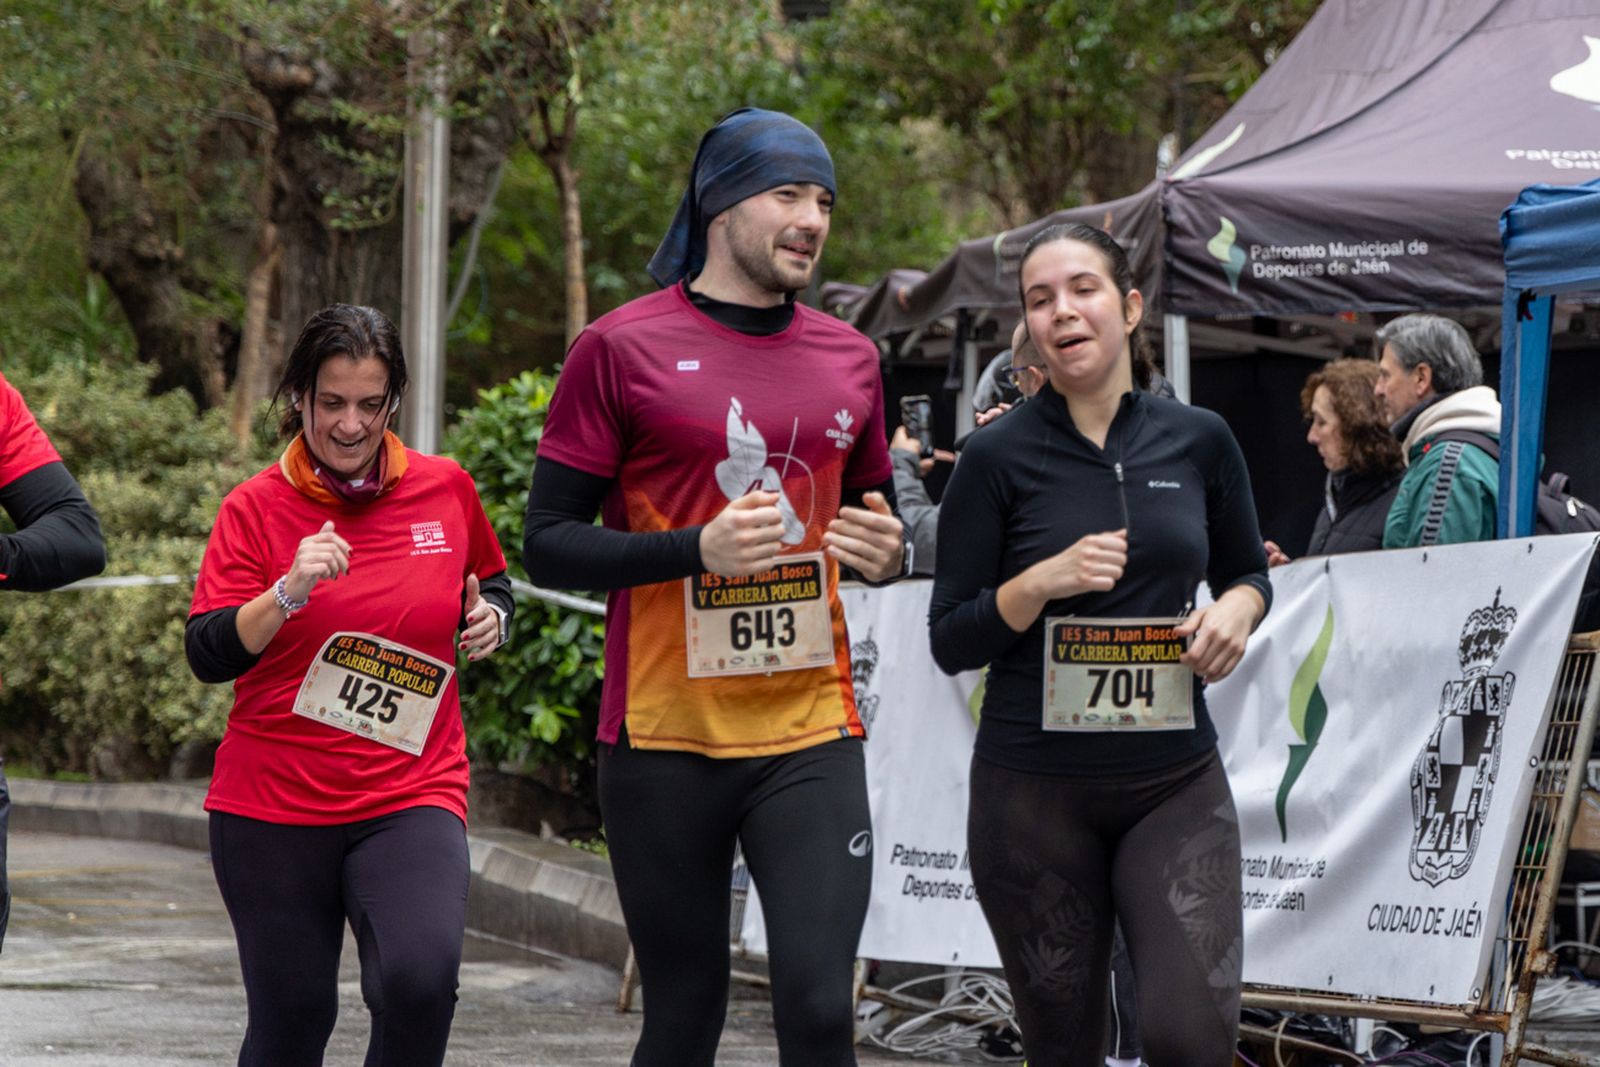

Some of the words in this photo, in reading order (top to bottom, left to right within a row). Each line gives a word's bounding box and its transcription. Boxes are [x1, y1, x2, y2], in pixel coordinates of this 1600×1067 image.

[1250, 243, 1326, 261] Patronato
[1329, 239, 1405, 258] Municipal
[1407, 239, 1429, 256] de
[1252, 262, 1325, 281] Deportes
[1327, 260, 1349, 276] de
[1351, 258, 1391, 275] Jaén
[701, 571, 722, 588] IES
[752, 569, 779, 584] Juan
[782, 565, 813, 580] Bosco
[697, 590, 708, 607] V
[711, 586, 768, 606] CARRERA
[770, 580, 817, 600] POPULAR
[730, 607, 796, 652] 643
[1062, 627, 1082, 641] IES
[1085, 628, 1110, 642] San
[1113, 628, 1142, 642] Juan
[1145, 627, 1179, 640] Bosco
[337, 636, 353, 649] IES
[354, 639, 375, 656] San
[375, 646, 403, 666] Juan
[405, 657, 439, 678] Bosco
[1057, 644, 1067, 660] V
[1070, 644, 1128, 661] CARRERA
[1131, 644, 1182, 661] POPULAR
[328, 647, 336, 662] V
[337, 650, 385, 679] CARRERA
[387, 667, 436, 695] POPULAR
[338, 674, 404, 725] 425
[1087, 668, 1154, 709] 704
[890, 843, 958, 870] Patronato
[902, 874, 963, 903] Deportes
[1367, 903, 1422, 934] CIUDAD
[1422, 906, 1445, 935] DE
[1444, 901, 1483, 938] JAÉN
